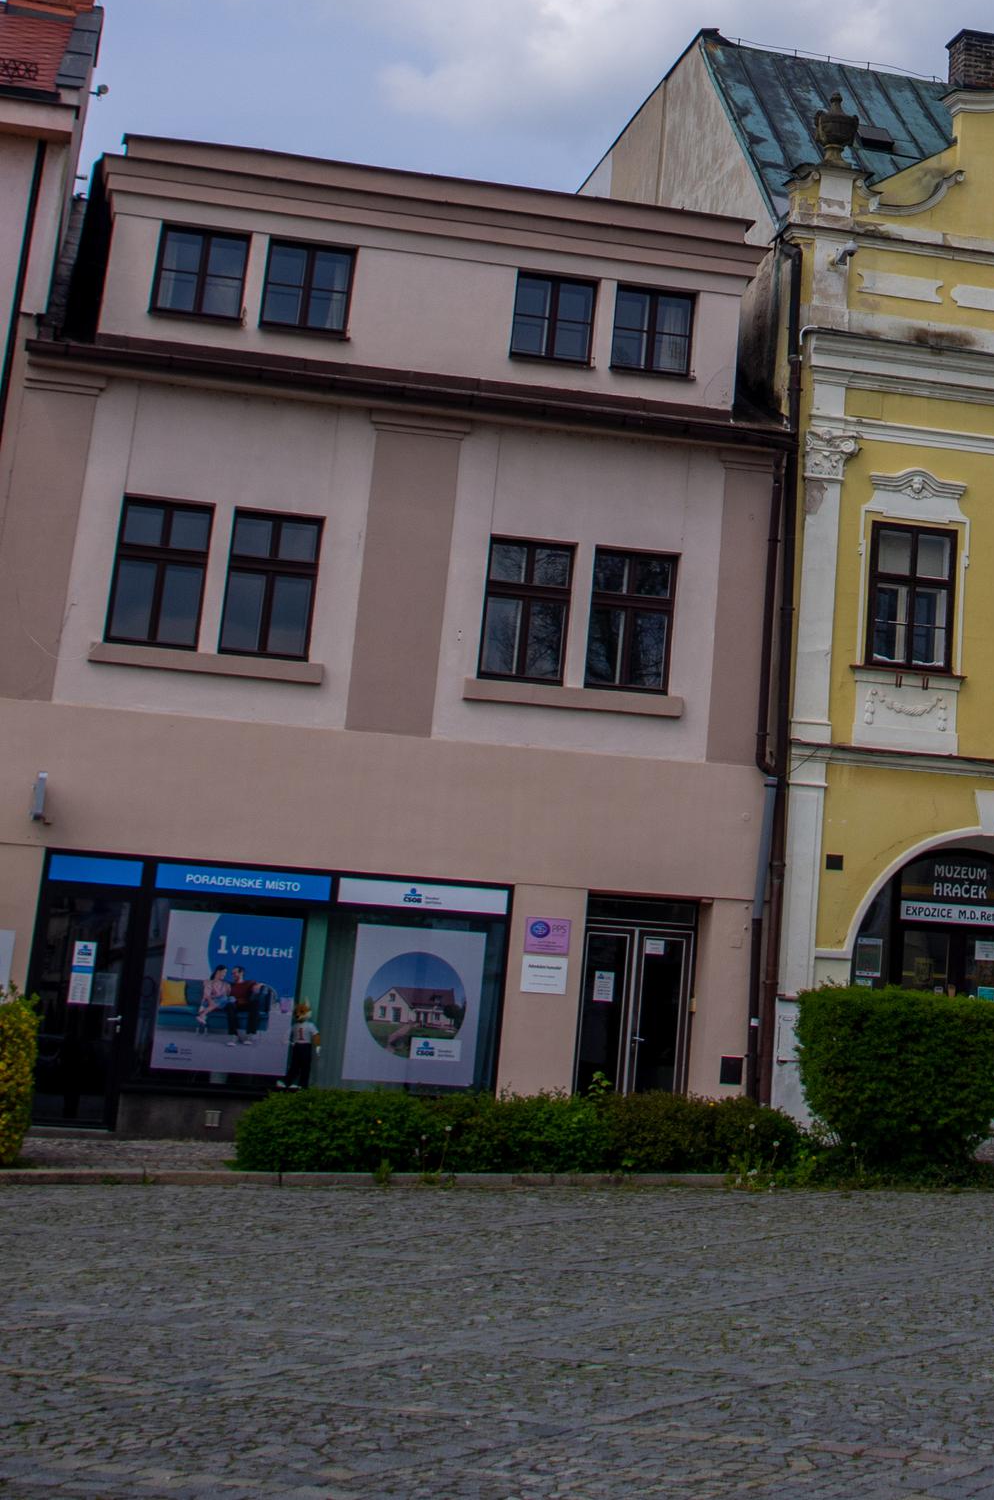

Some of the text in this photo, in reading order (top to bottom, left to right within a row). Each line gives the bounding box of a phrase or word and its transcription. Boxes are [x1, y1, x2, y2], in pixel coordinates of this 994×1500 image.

[935, 864, 988, 880] MUZEUM
[186, 873, 302, 892] PORADENSKÉ MÍSTO
[933, 881, 988, 899] HRAČEK
[906, 905, 953, 918] EXPOZICE
[959, 909, 980, 921] M.D.
[217, 935, 294, 959] 1 V BYDLENÍ
